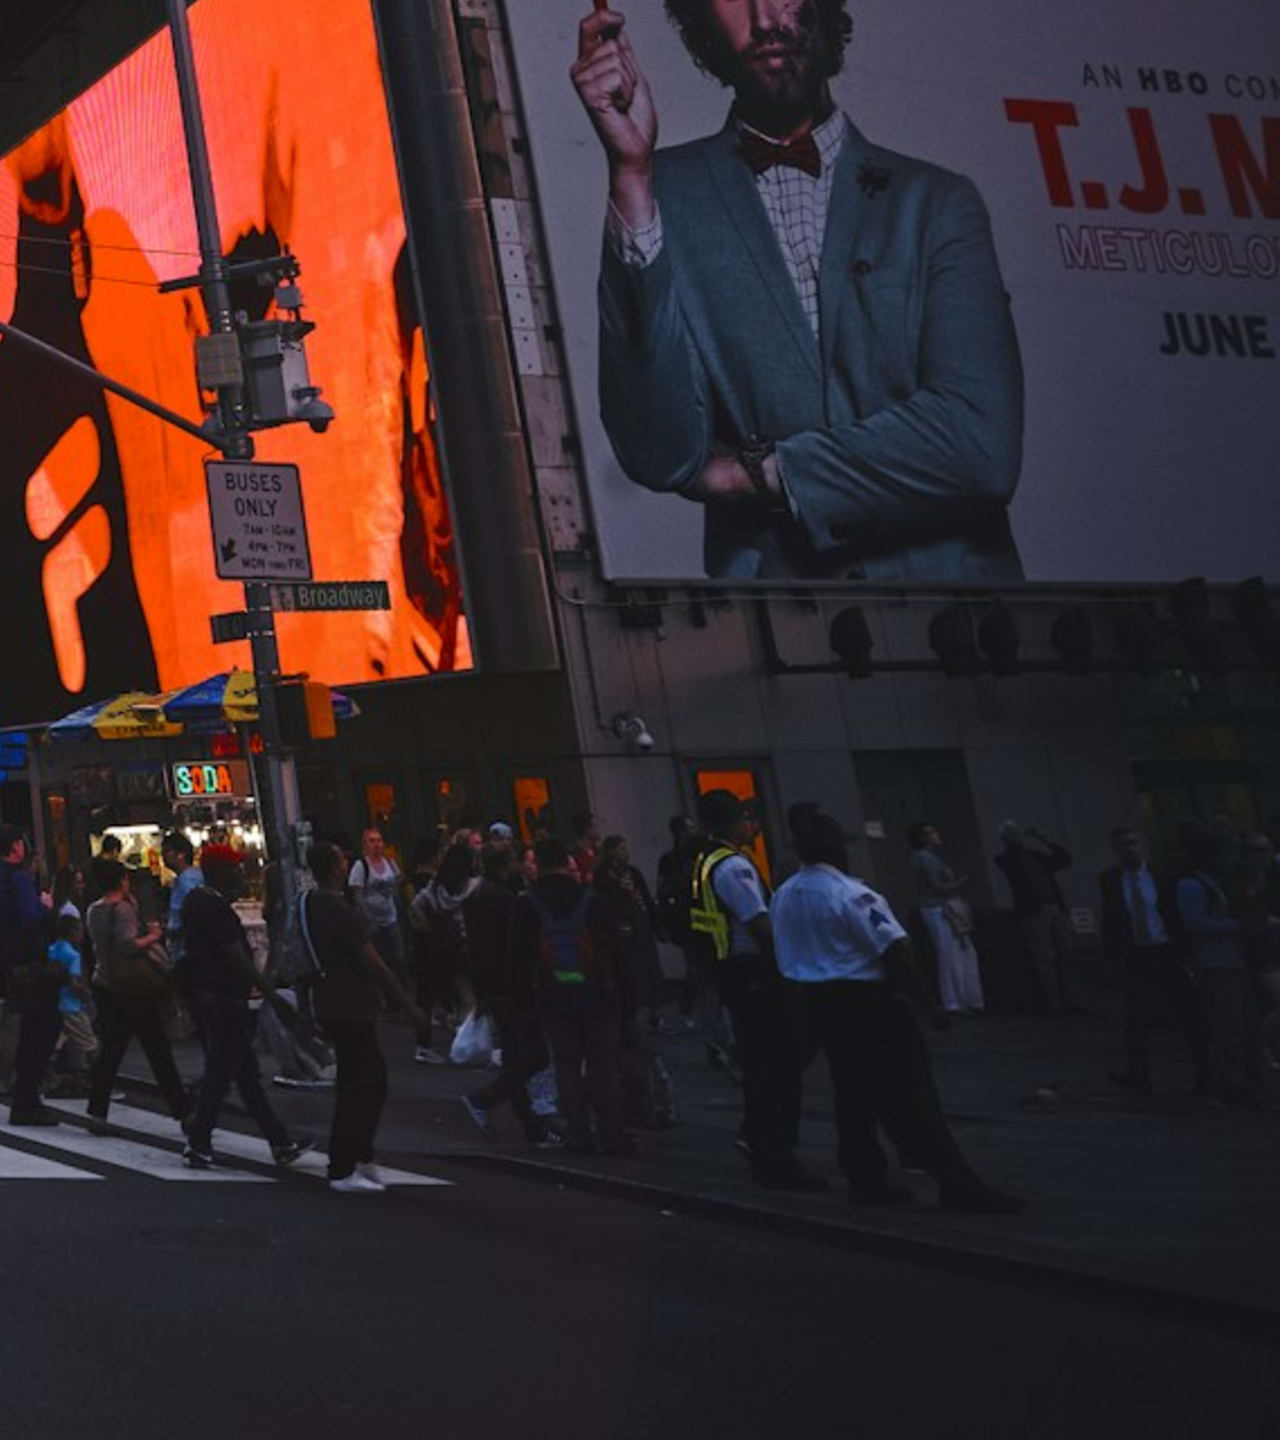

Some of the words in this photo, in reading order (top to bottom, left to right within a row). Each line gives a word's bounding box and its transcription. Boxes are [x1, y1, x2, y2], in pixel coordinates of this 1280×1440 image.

[1082, 62, 1123, 89] AN
[1137, 67, 1208, 96] HBO
[1055, 222, 1280, 280] METICULO
[1159, 311, 1276, 359] JUNE
[224, 471, 283, 493] BUSES
[234, 497, 278, 518] ONLY
[297, 586, 385, 609] Broadway
[176, 764, 234, 796] SODA
